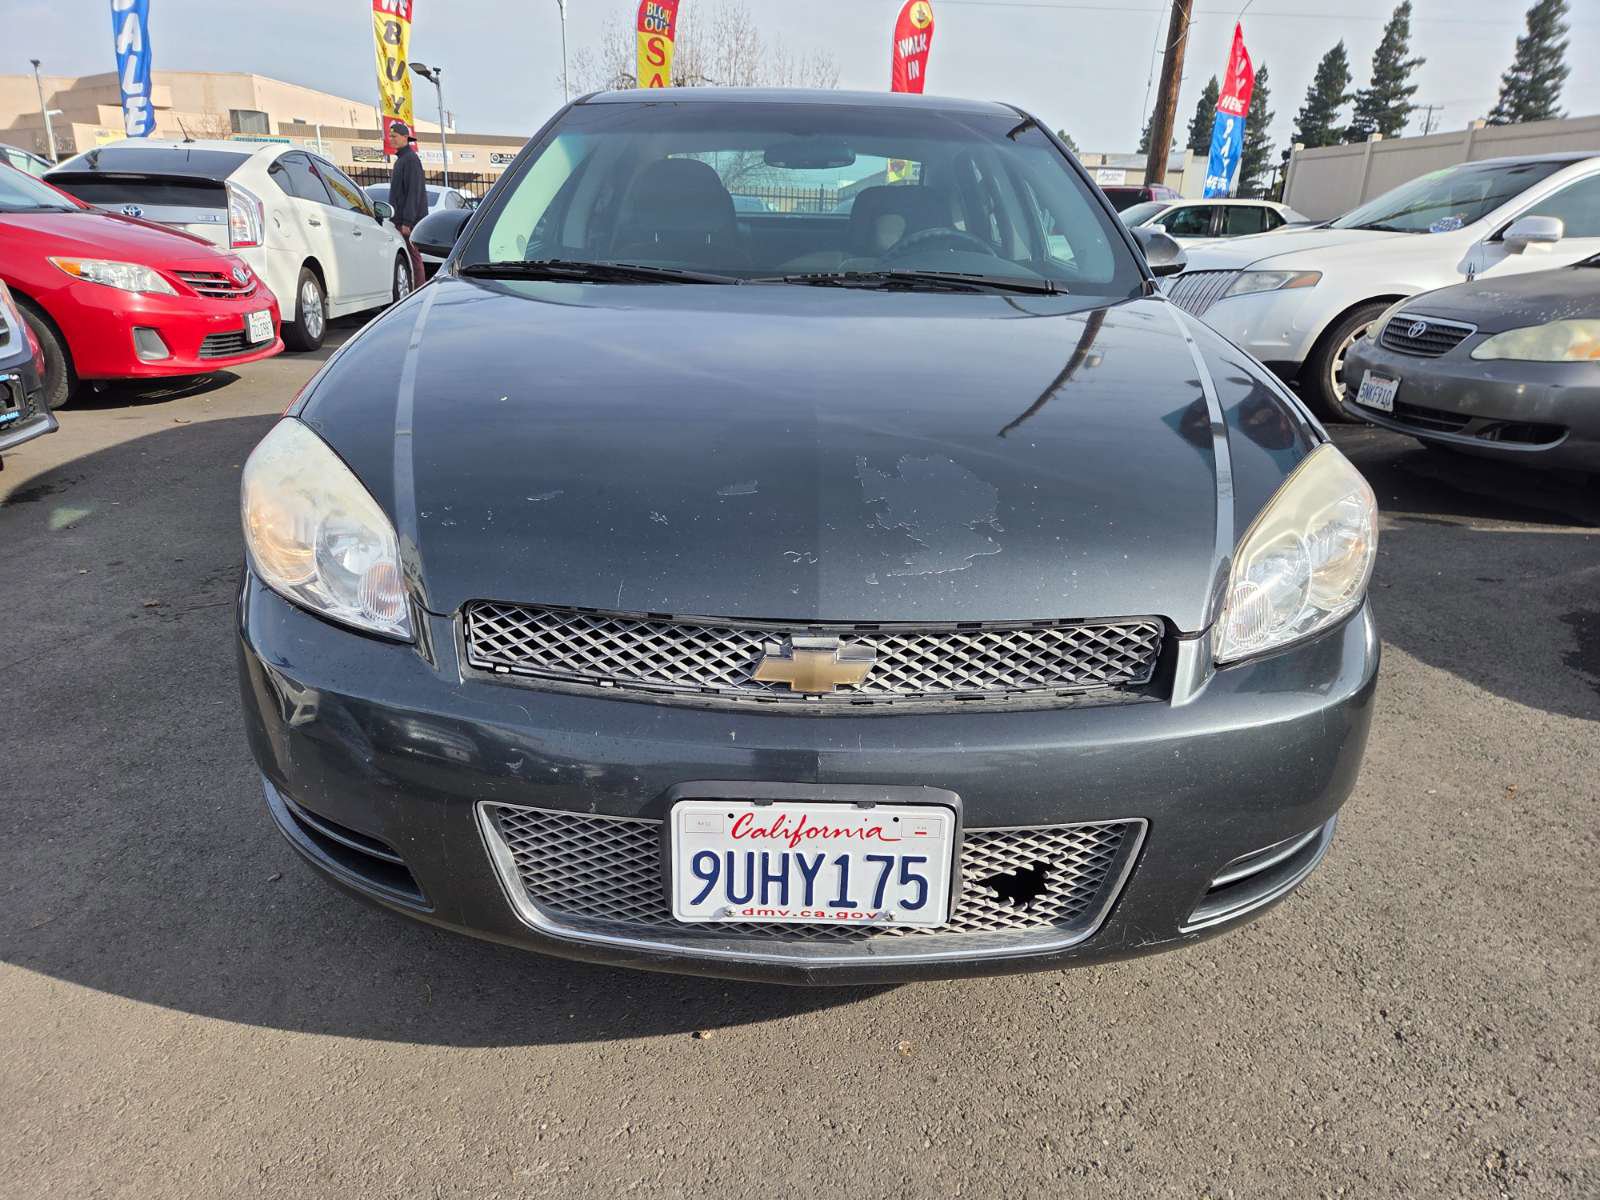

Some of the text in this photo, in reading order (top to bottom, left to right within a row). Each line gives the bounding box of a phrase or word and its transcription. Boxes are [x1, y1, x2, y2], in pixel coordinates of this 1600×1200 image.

[645, 17, 669, 35] OUT
[898, 33, 927, 58] WALK
[383, 20, 405, 114] BUY
[908, 60, 919, 80] IN
[731, 812, 901, 848] California
[690, 850, 928, 911] 9UHY175
[742, 908, 877, 920] dmv.ca.gov
